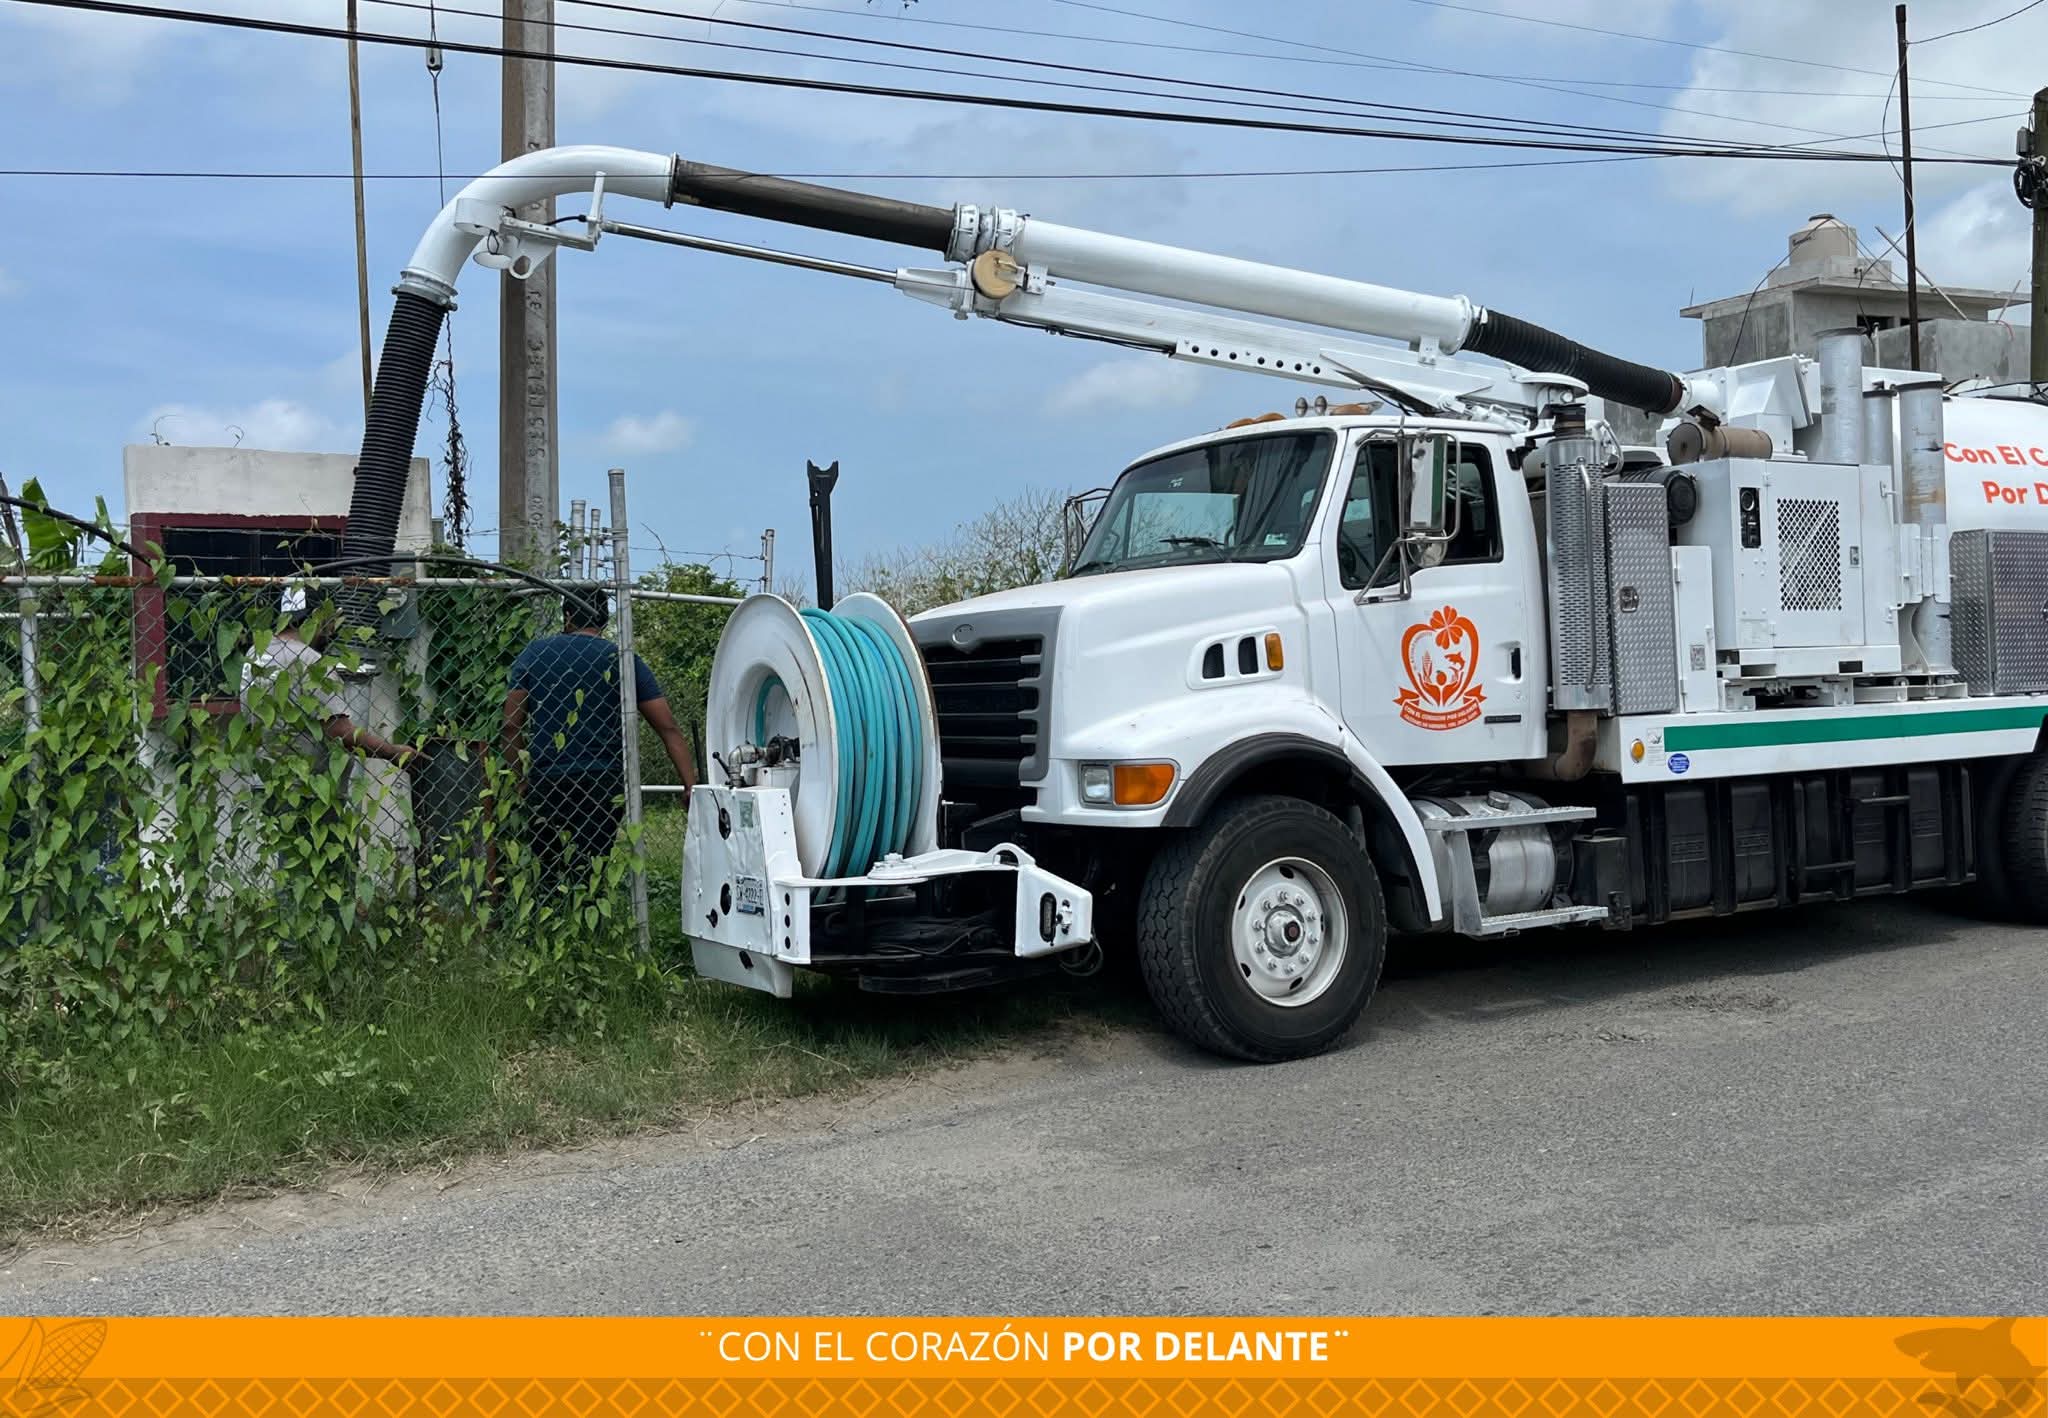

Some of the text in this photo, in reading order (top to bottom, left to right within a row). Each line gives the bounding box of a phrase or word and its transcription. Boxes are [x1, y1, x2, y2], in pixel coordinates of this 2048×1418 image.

[1944, 443, 1997, 464] Con
[1996, 446, 2027, 466] El
[1982, 481, 2028, 504] Por
